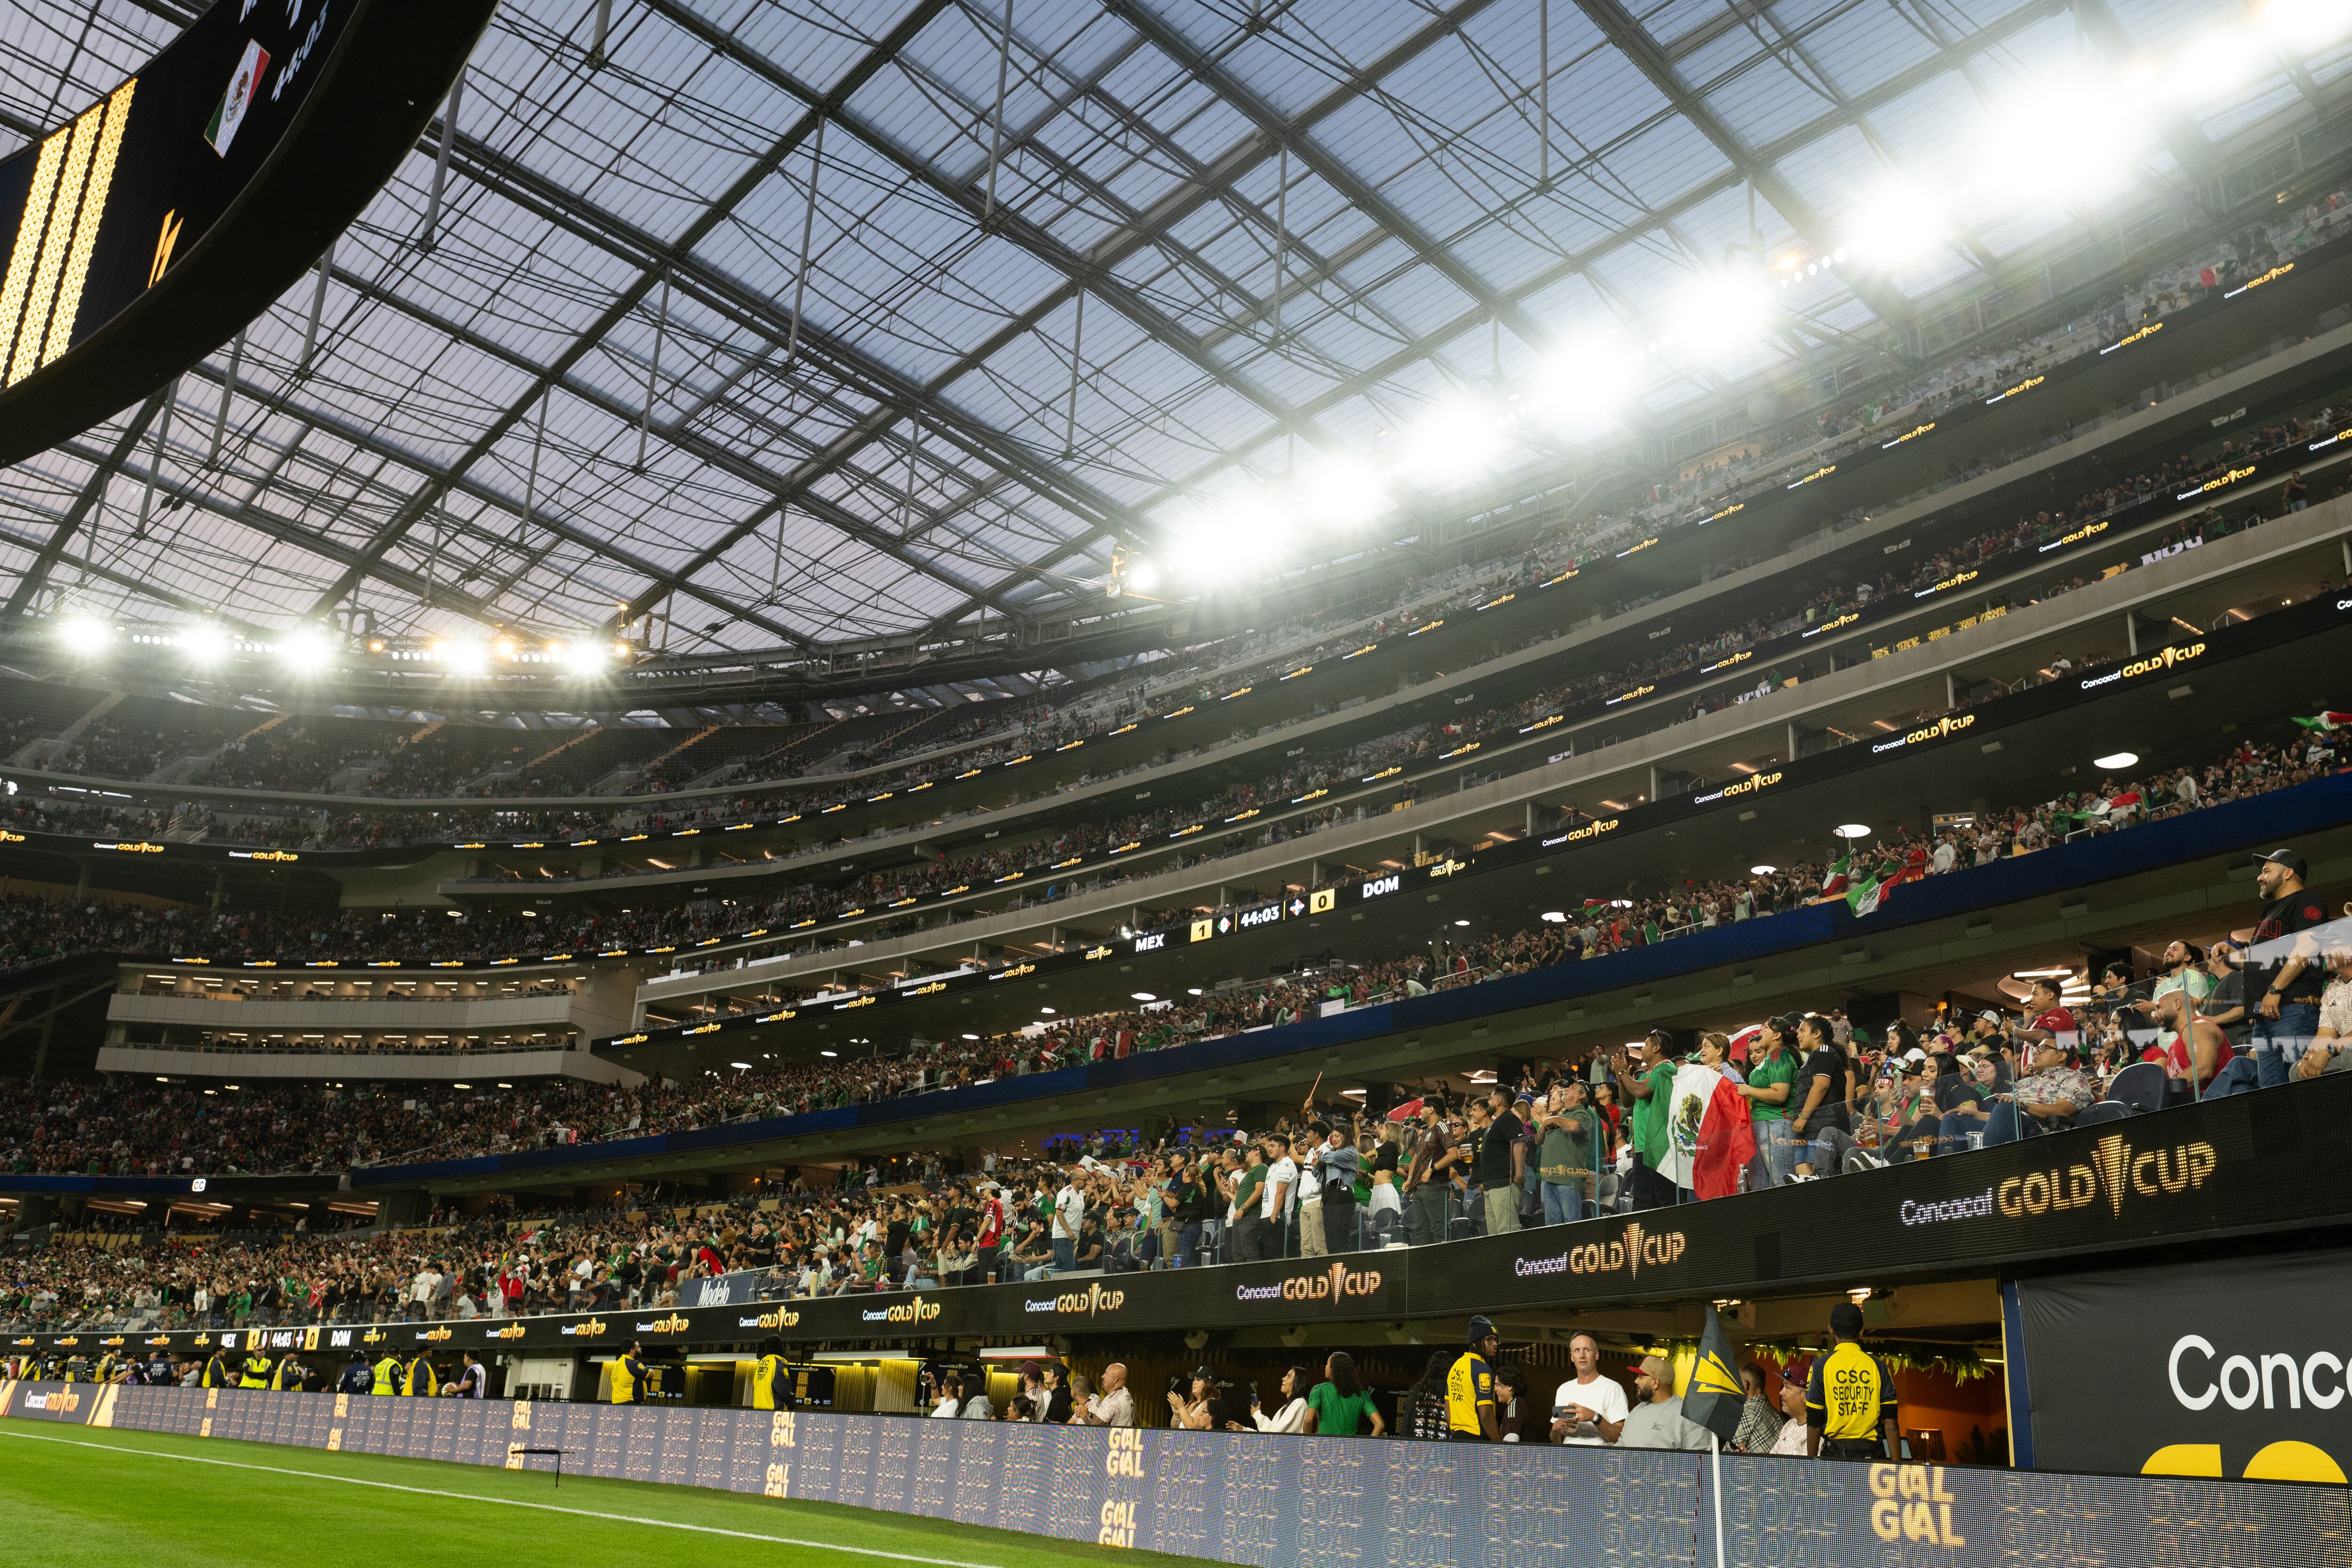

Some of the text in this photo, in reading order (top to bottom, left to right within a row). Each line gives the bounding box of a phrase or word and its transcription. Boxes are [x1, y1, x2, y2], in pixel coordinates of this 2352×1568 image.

[2204, 477, 2229, 491] GOLD
[2237, 467, 2256, 478] CUP
[2063, 532, 2084, 544] GOLD
[2091, 523, 2108, 533] CUP
[1937, 580, 1956, 590] GOLD
[1963, 572, 1978, 581] CUP
[1822, 621, 1840, 631] GOLD
[1845, 614, 1859, 623] CUP
[2082, 644, 2205, 689] Concacaf GOLD CUP
[1623, 692, 1638, 700] GOLD
[1873, 715, 1975, 753] Concacaf GOLD CUP
[1695, 773, 1782, 804] Concacaf GOLD CUP
[1542, 820, 1618, 846] Concacaf GOLD CUP
[281, 853, 298, 861] CUP
[1430, 862, 1465, 877] GOLD CUP
[1136, 934, 1165, 952] MEX
[1240, 906, 1279, 927] 44:03
[1318, 895, 1327, 908] 0
[1363, 876, 1399, 898] DOM
[1005, 969, 1019, 978] GOLD
[1900, 1141, 2217, 1226] Concacaf GOLD CUP
[1516, 1232, 1685, 1275] Concacaf GOLD CUP
[697, 1280, 730, 1306] Modelo
[1237, 1272, 1380, 1299] Concacaf GOLD CUP
[1025, 1291, 1123, 1313] Concacaf GOLD CUP
[739, 1312, 799, 1328] Concacaf GOLD CUP
[863, 1304, 940, 1322] Concacaf GOLD CUP
[576, 1324, 590, 1336] GOLD
[595, 1322, 606, 1335] CUP
[654, 1321, 671, 1333] GOLD
[676, 1319, 689, 1332] CUP
[221, 1333, 237, 1348] MEX
[271, 1332, 293, 1347] 44:03
[331, 1330, 351, 1346] DOM
[1836, 1369, 1870, 1384] CSC
[2168, 1334, 2352, 1411] Conc
[46, 1392, 63, 1411] GOLD
[65, 1393, 79, 1412] CUP
[1833, 1386, 1874, 1401] SECURITY
[1838, 1401, 1868, 1417] STAFF
